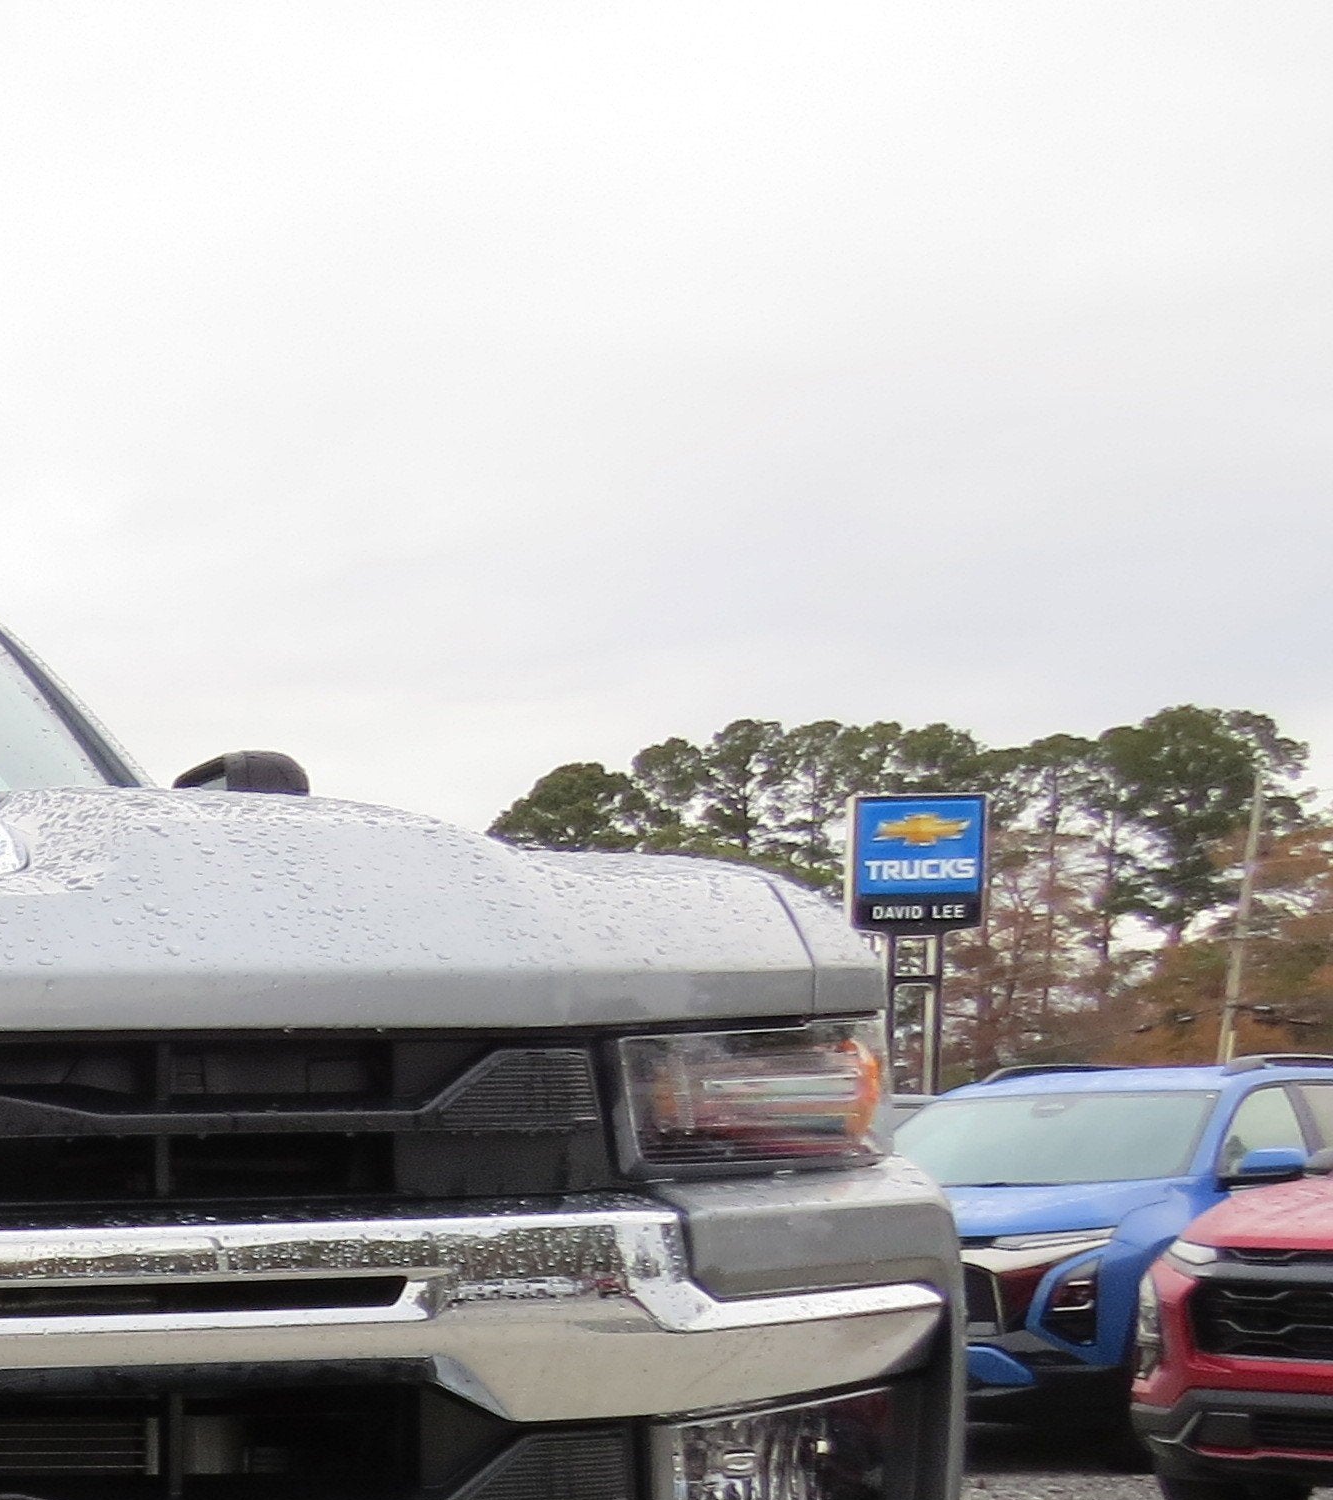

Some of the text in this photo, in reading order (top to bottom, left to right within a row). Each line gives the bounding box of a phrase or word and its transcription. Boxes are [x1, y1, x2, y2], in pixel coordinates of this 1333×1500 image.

[864, 857, 976, 881] TRUCKS
[872, 903, 966, 920] DAVID LEE
